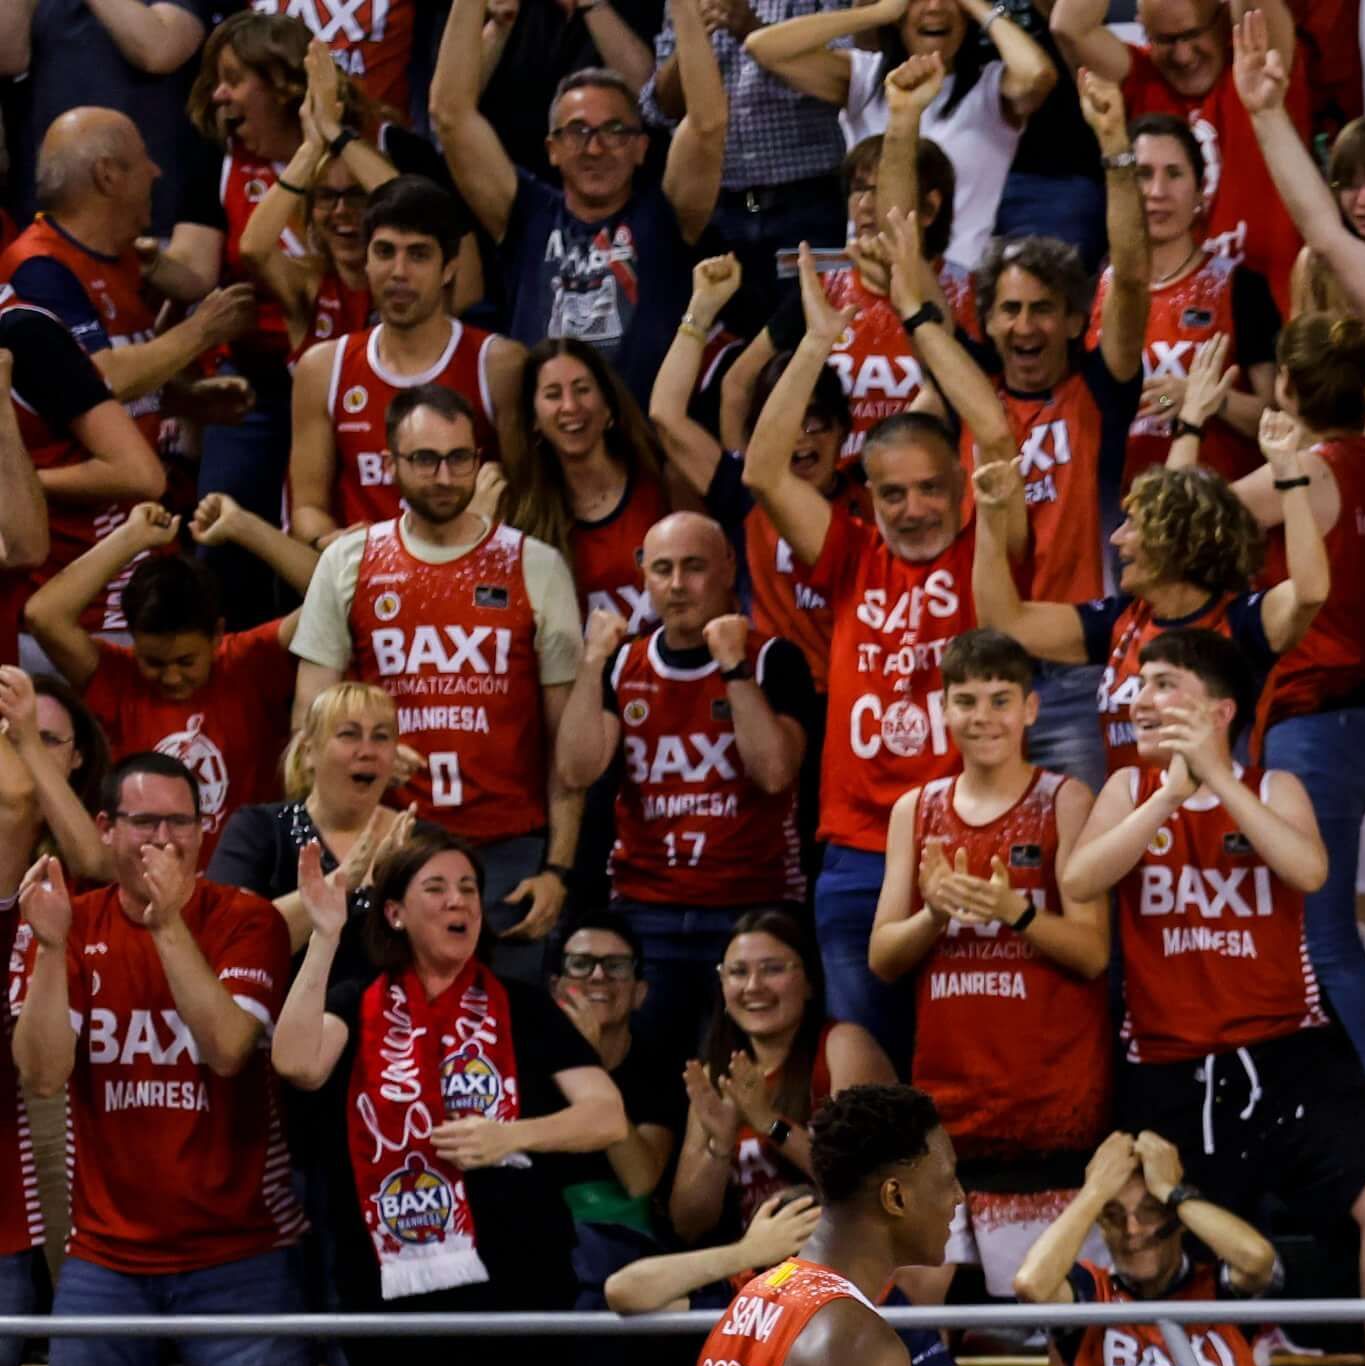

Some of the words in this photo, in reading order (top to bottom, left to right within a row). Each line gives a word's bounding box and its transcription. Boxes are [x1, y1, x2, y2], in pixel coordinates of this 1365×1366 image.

[371, 624, 512, 677] BAXI
[397, 705, 490, 735] MANRESA
[662, 831, 707, 867] 17
[1140, 864, 1274, 919] BAXI
[931, 971, 1027, 1001] MANRESA
[104, 1079, 211, 1113] MANRESA
[381, 1186, 451, 1218] BAXI
